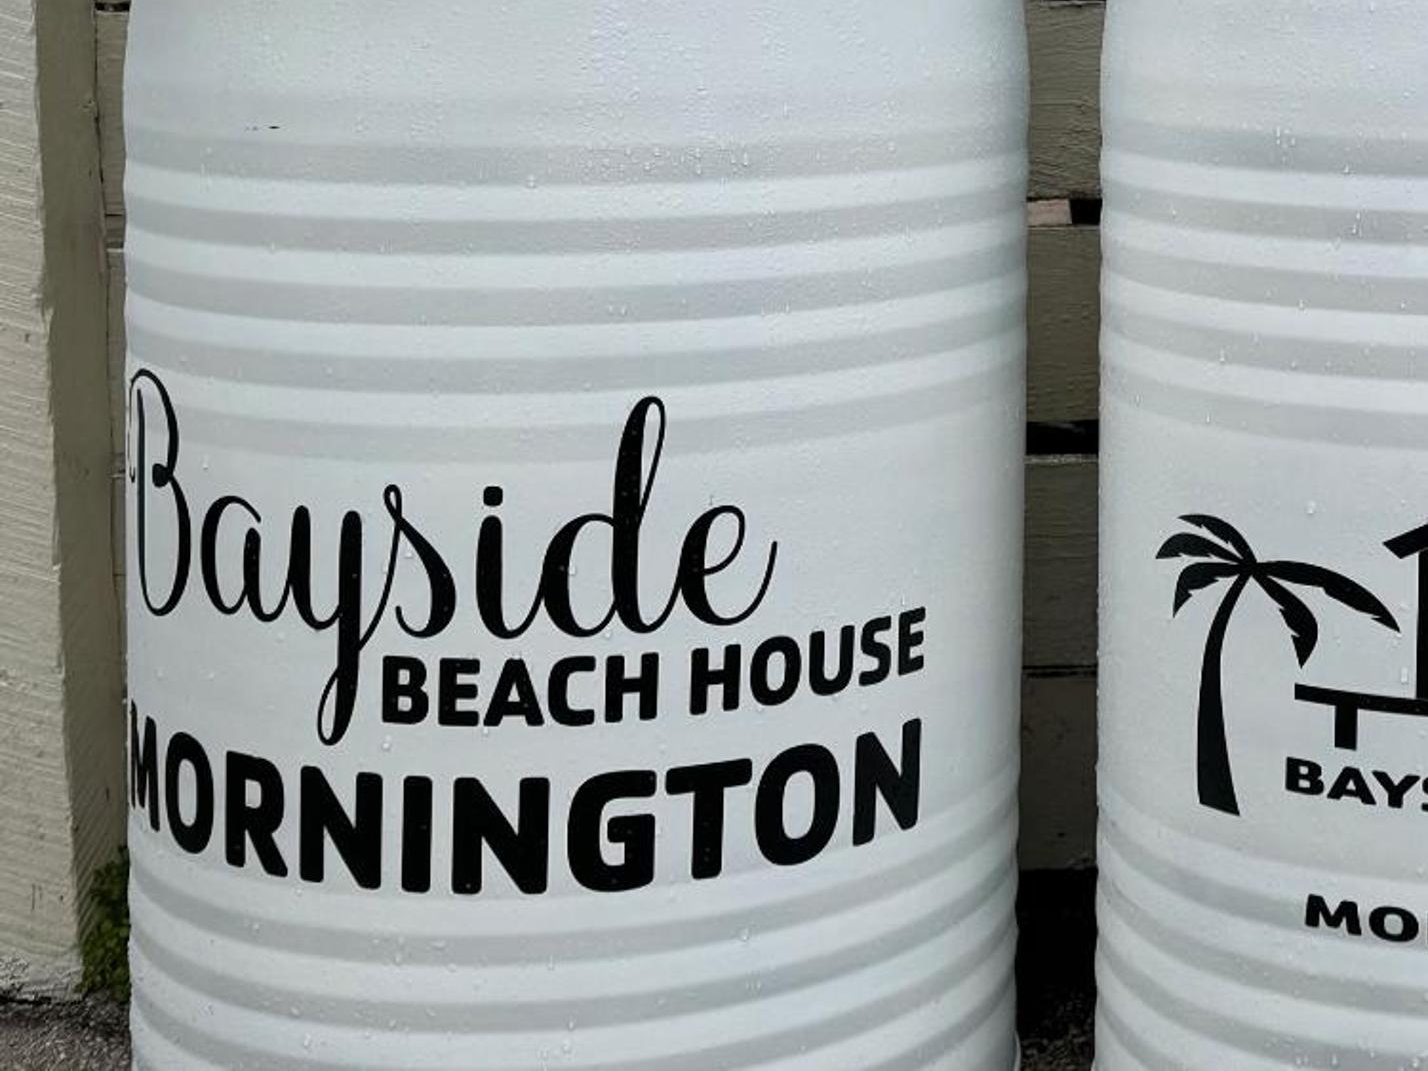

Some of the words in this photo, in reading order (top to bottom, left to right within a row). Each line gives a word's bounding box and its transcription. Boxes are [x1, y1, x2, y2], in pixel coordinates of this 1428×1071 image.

[129, 368, 777, 746] Bayside
[381, 652, 660, 727] BEACH
[689, 606, 926, 716] HOUSE
[129, 699, 922, 895] MORNINGTON
